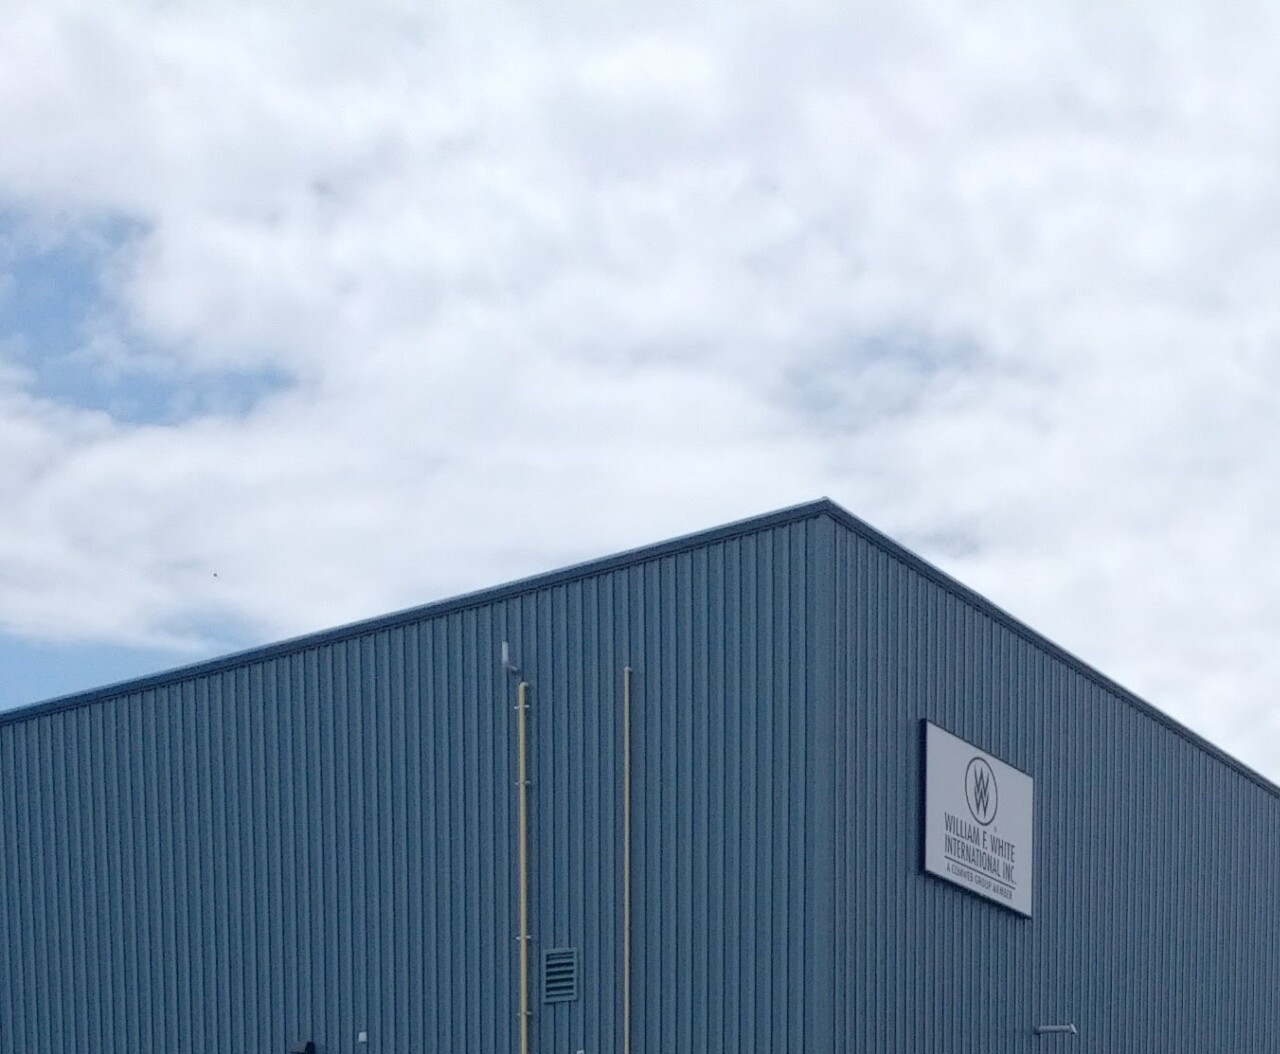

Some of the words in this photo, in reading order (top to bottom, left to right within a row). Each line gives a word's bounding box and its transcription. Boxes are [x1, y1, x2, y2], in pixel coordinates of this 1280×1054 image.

[944, 811, 980, 846] WILLIAM
[990, 834, 1015, 863] WHITE
[944, 833, 1001, 877] INTERNATIONAL
[1003, 861, 1017, 885] INC.
